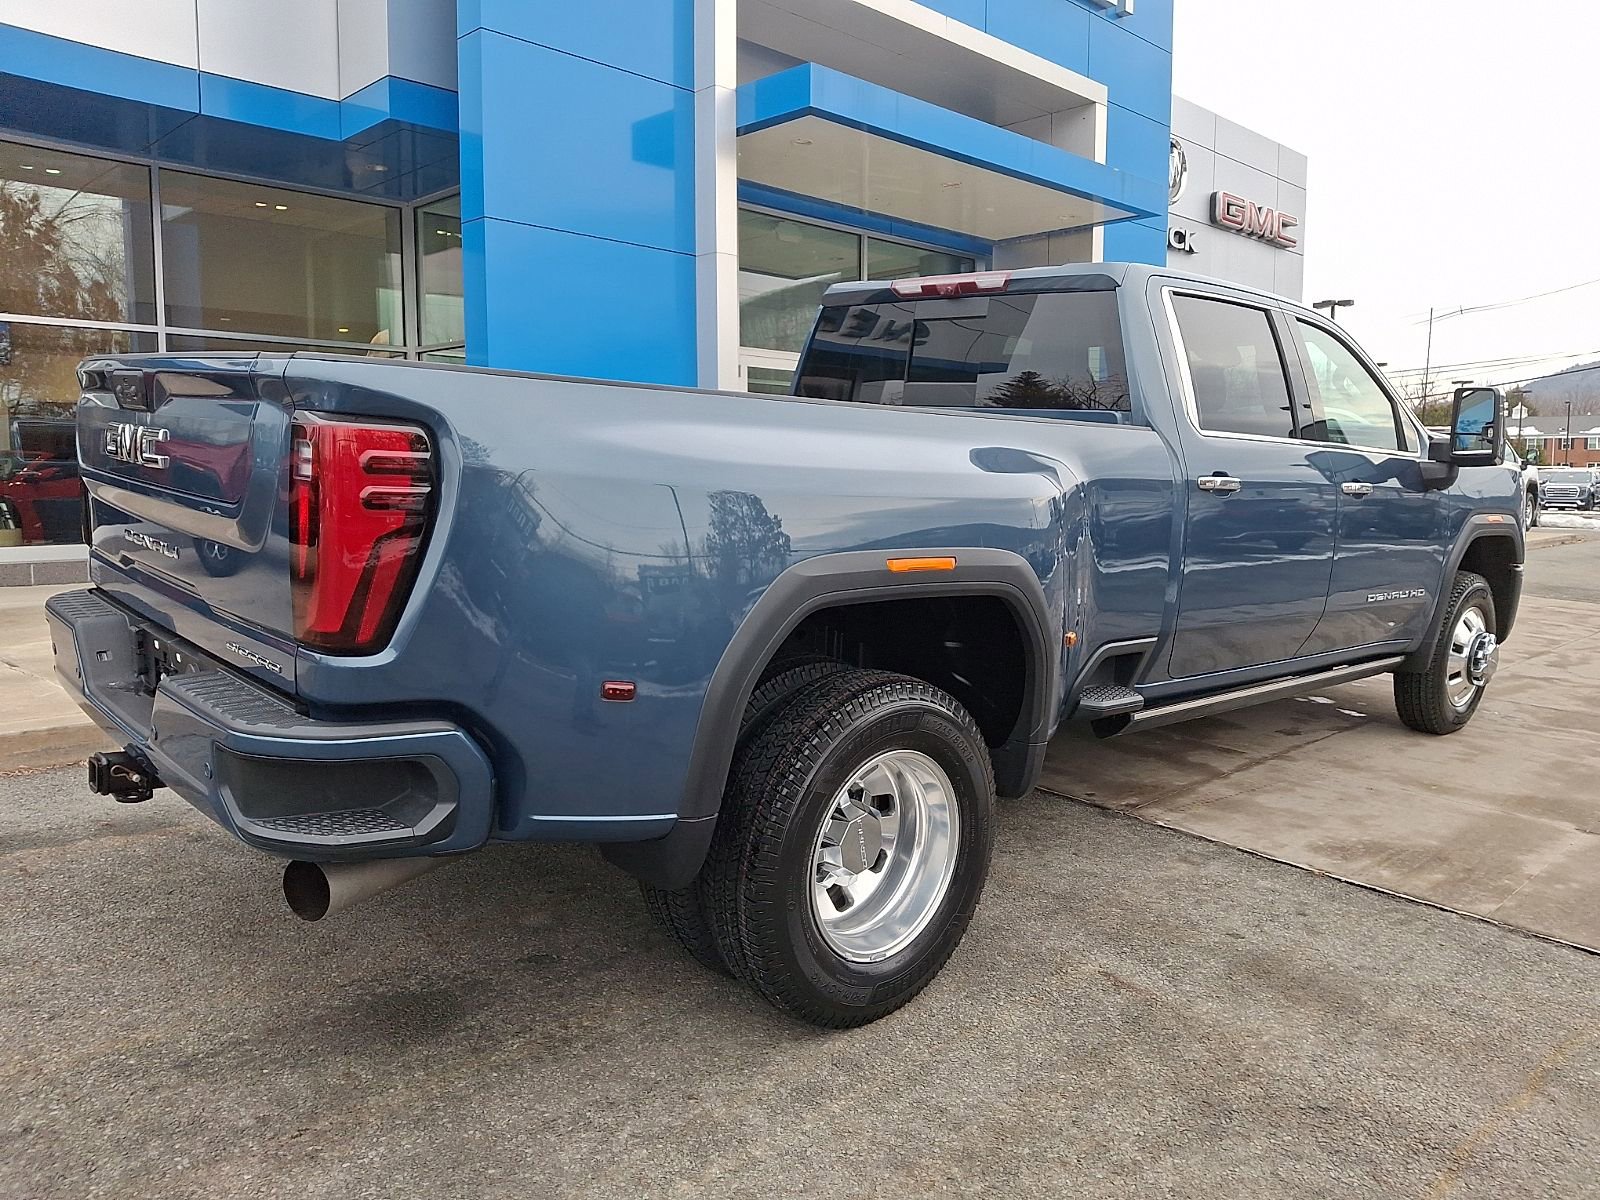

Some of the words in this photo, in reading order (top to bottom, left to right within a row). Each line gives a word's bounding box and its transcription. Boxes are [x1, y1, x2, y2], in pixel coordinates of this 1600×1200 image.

[1218, 191, 1298, 248] GMC
[105, 421, 170, 469] GMC
[123, 528, 180, 560] DENALI
[1367, 590, 1409, 602] DENALI
[1410, 588, 1426, 597] HD
[225, 640, 283, 674] SIERRA
